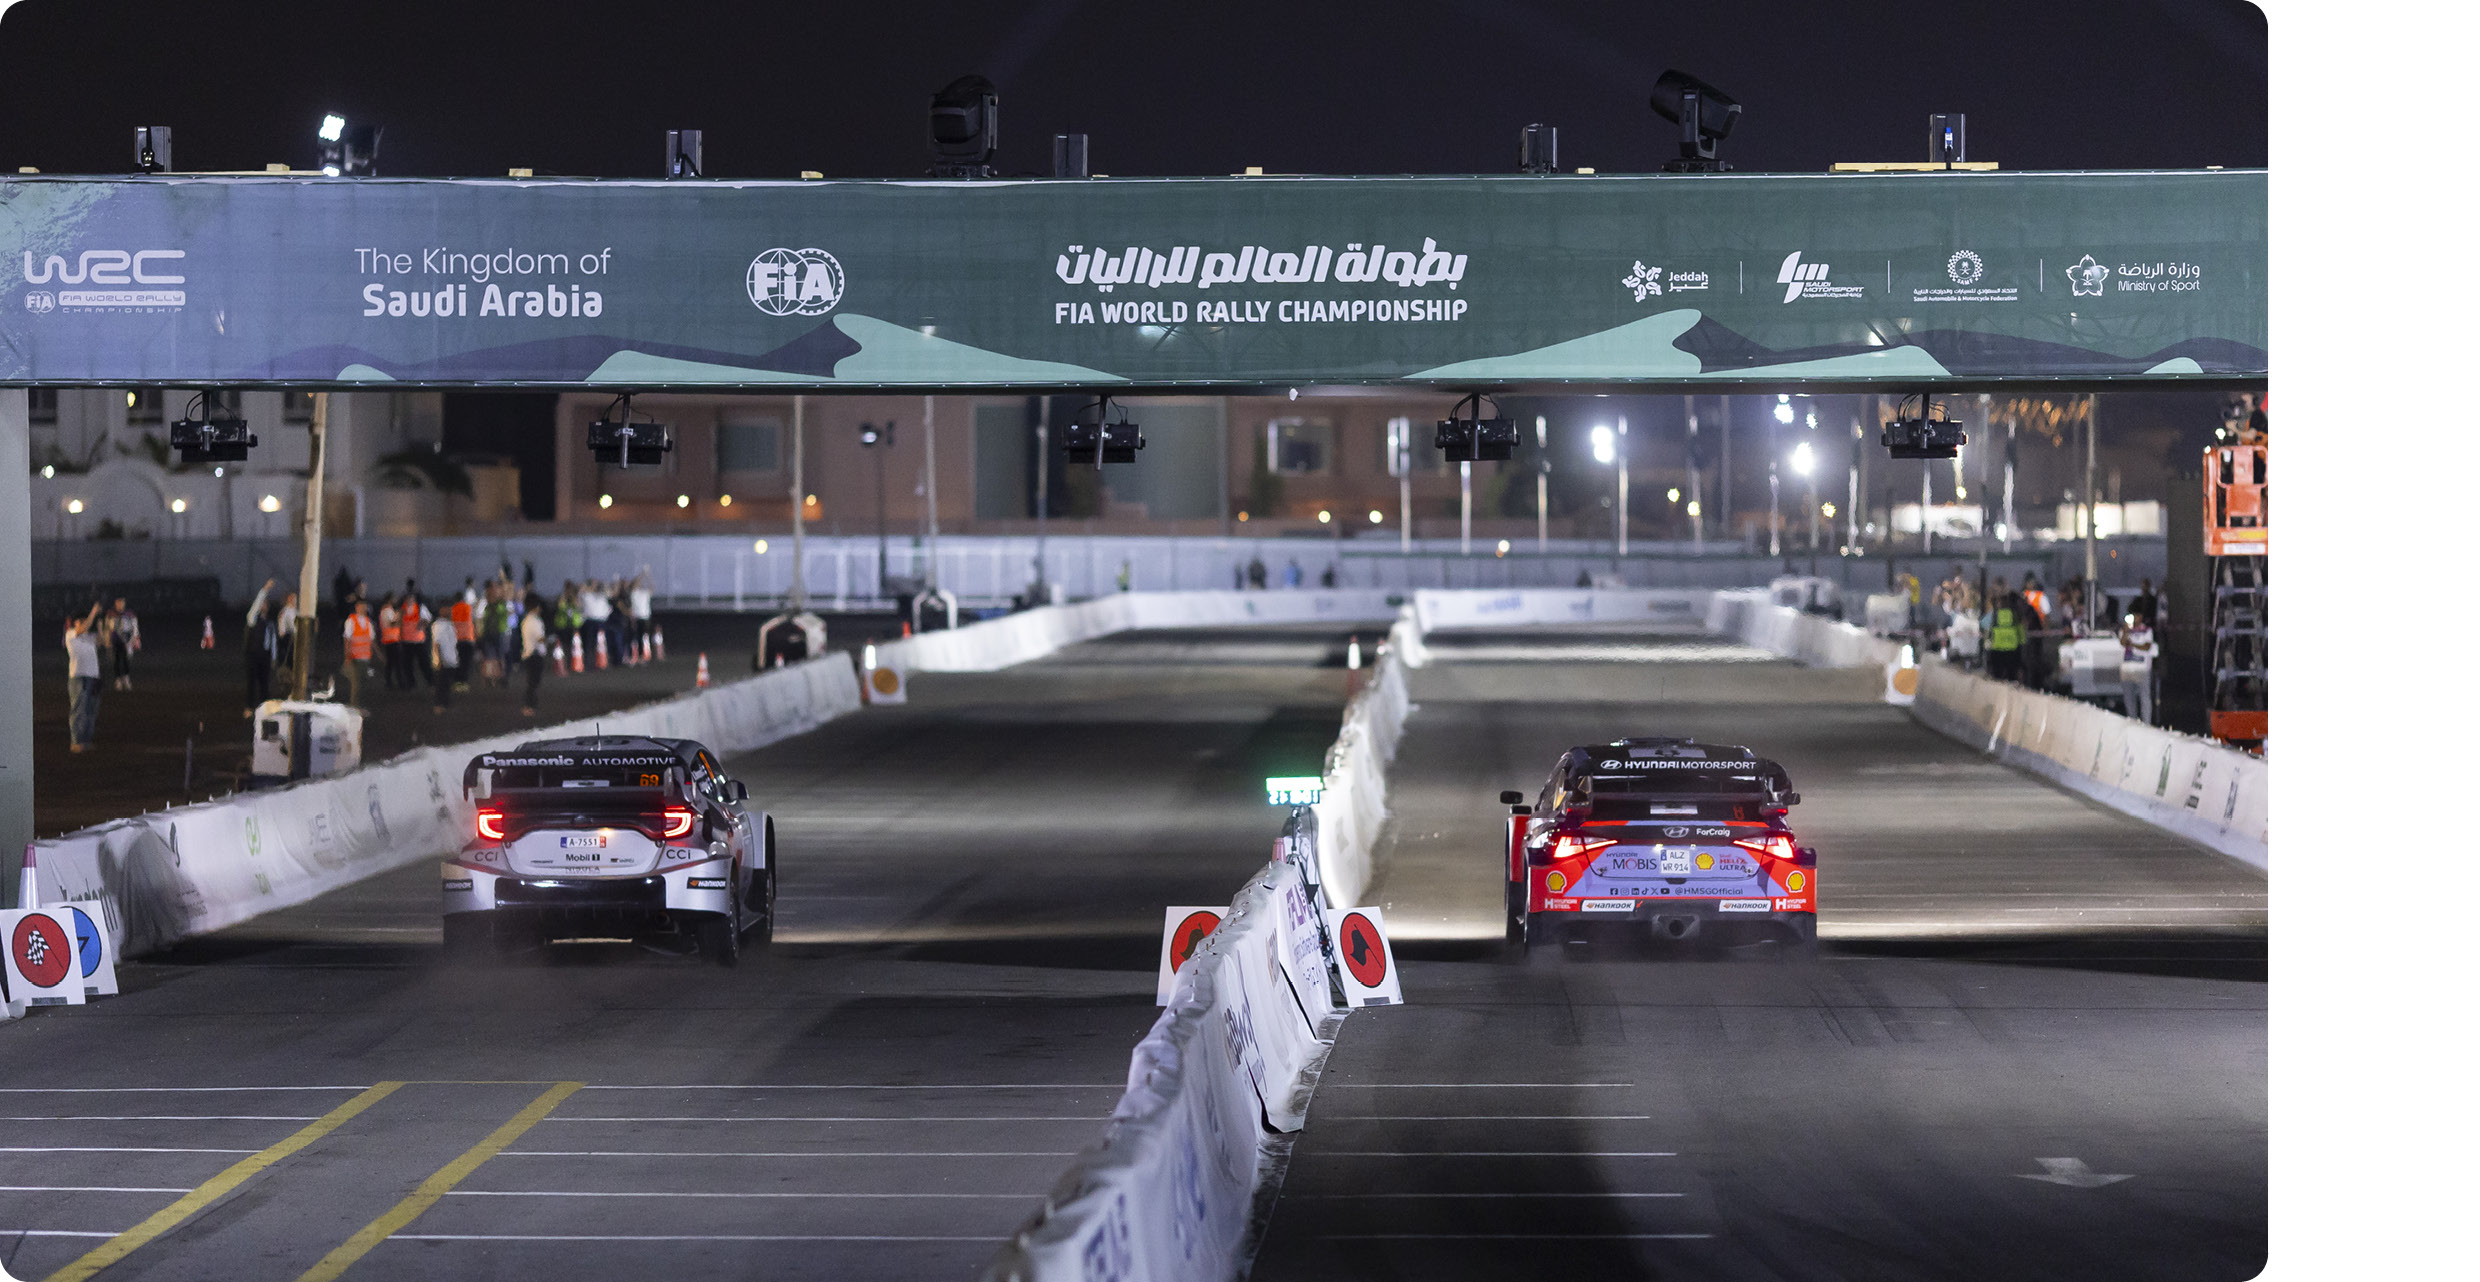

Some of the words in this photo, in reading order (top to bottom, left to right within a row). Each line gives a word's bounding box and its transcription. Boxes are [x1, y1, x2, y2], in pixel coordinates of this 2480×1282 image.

[24, 250, 186, 284] WRC
[354, 247, 412, 274] The
[423, 247, 569, 283] Kingdom
[579, 246, 612, 275] of
[1055, 244, 1201, 293] للراليات
[1197, 245, 1333, 289] العالم
[1334, 236, 1468, 290] بطولة
[2117, 262, 2164, 279] الرياضة
[2168, 262, 2200, 279] وزارة
[753, 262, 835, 301] FIA
[1668, 271, 1708, 282] Jeddah
[2118, 280, 2156, 293] Ministry
[2158, 280, 2169, 291] of
[2171, 280, 2200, 293] Sport
[62, 294, 82, 302] FIA
[86, 294, 132, 302] WORLD
[136, 294, 182, 302] RALLY
[363, 283, 467, 318] Saudi
[479, 283, 603, 318] Arabia
[1055, 302, 1095, 324] FIA
[1101, 301, 1188, 323] WORLD
[1197, 300, 1272, 323] RALLY
[1278, 299, 1469, 322] CHAMPIONSHIP
[482, 755, 574, 767] Panasonic
[582, 757, 676, 766] AUTOMOTIVE
[1624, 761, 1680, 769] HYUNDAI
[1681, 761, 1757, 769] MOTORSPORT
[639, 773, 659, 786] 69
[566, 853, 590, 861] Mobil
[1613, 858, 1657, 870] MOBIS
[1662, 863, 1673, 871] WR
[1674, 886, 1744, 896] @HMSGOfficial
